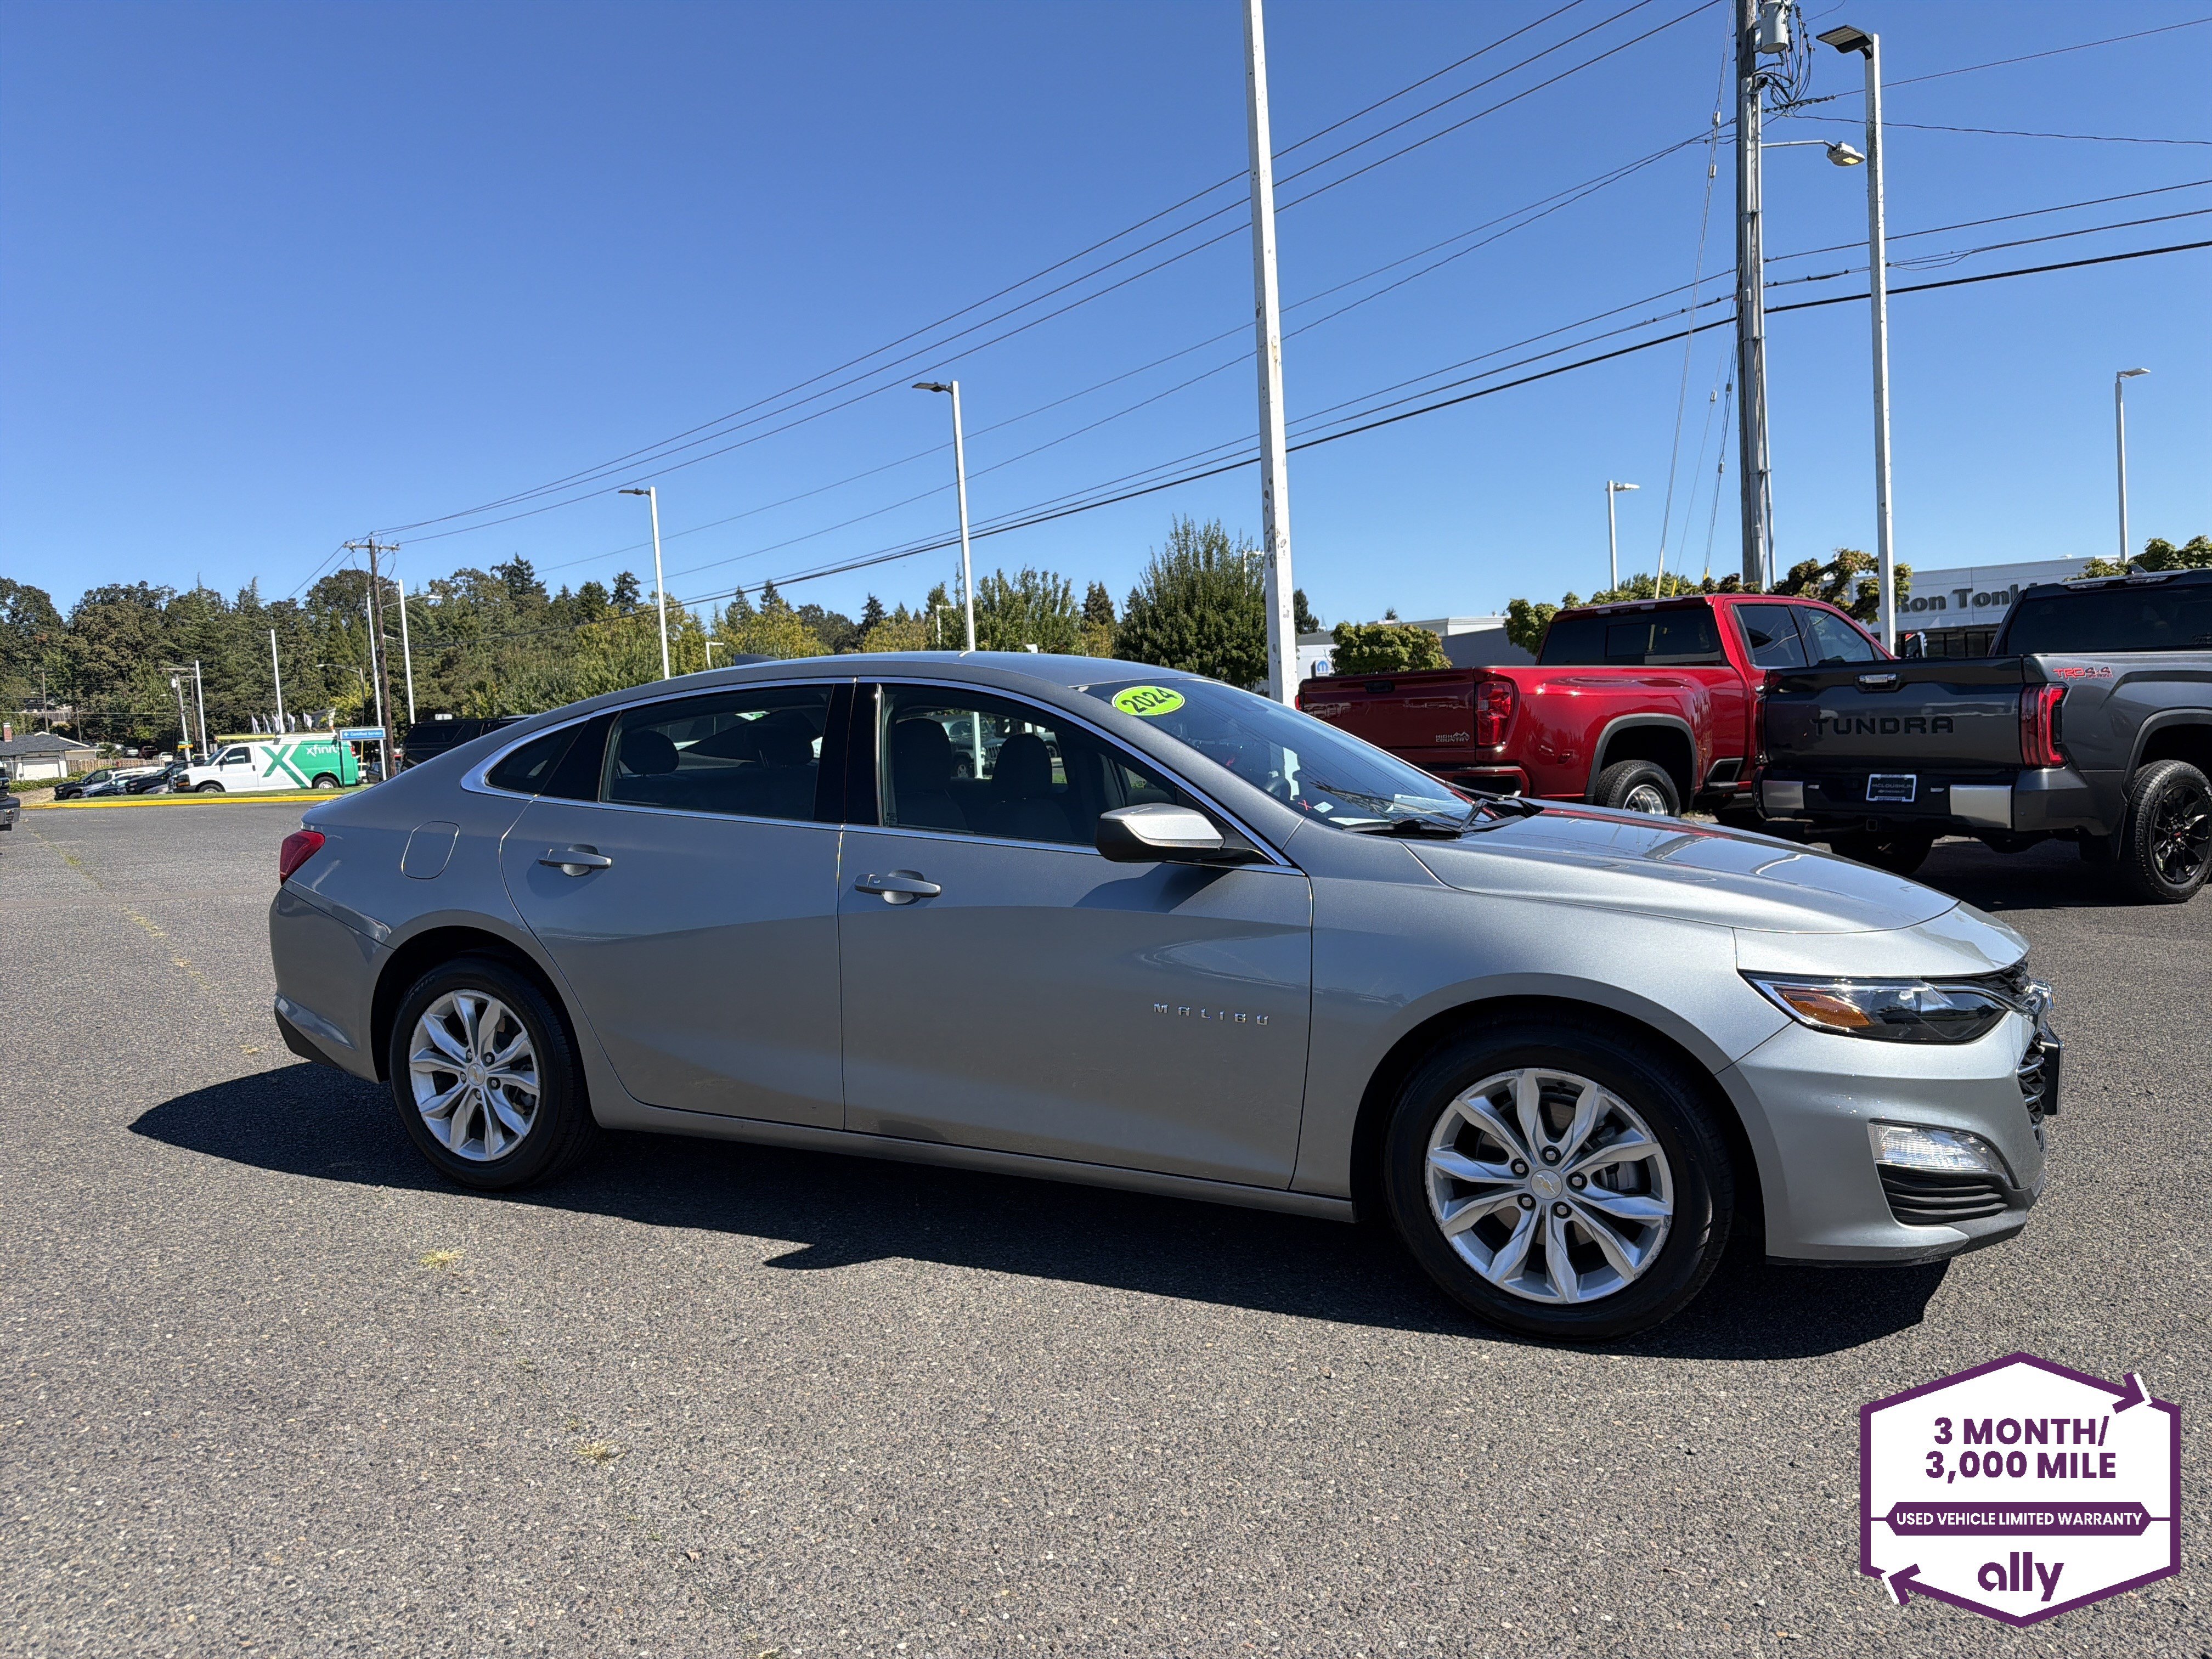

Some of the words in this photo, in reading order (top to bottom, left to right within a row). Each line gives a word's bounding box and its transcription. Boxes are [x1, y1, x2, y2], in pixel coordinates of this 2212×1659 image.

[1895, 594, 1946, 613] Ron
[1953, 583, 2037, 608] Ton
[2053, 667, 2085, 680] TRD
[1121, 688, 1178, 713] 2024
[1810, 715, 1954, 736] TUNDRA
[1154, 1002, 1269, 1025] MALIBU
